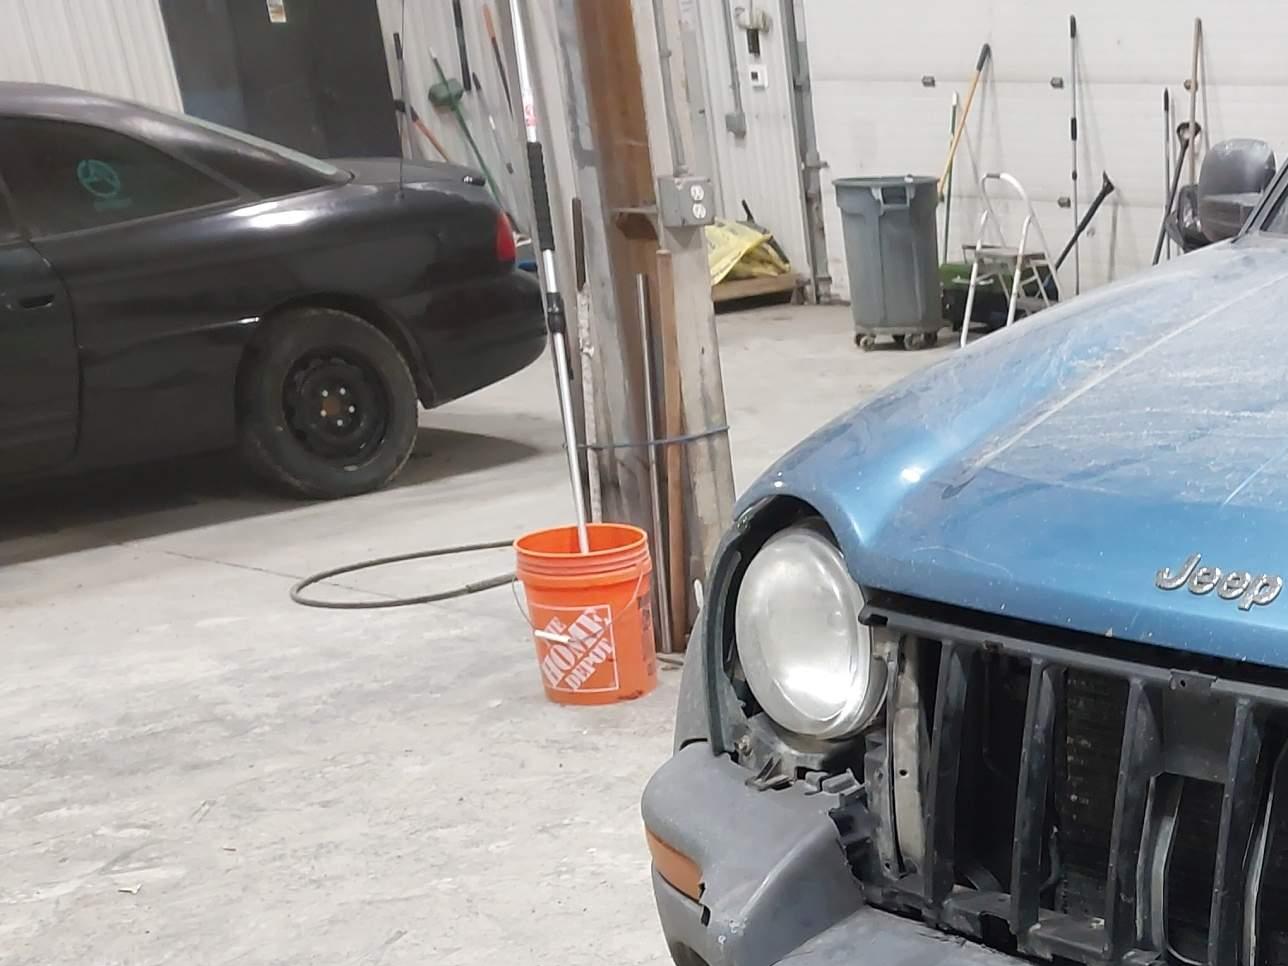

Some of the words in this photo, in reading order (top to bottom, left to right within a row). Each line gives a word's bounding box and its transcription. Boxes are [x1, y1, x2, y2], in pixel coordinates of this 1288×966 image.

[1156, 552, 1283, 611] Jeep
[542, 608, 611, 687] HOME
[564, 637, 612, 689] DEPOT
